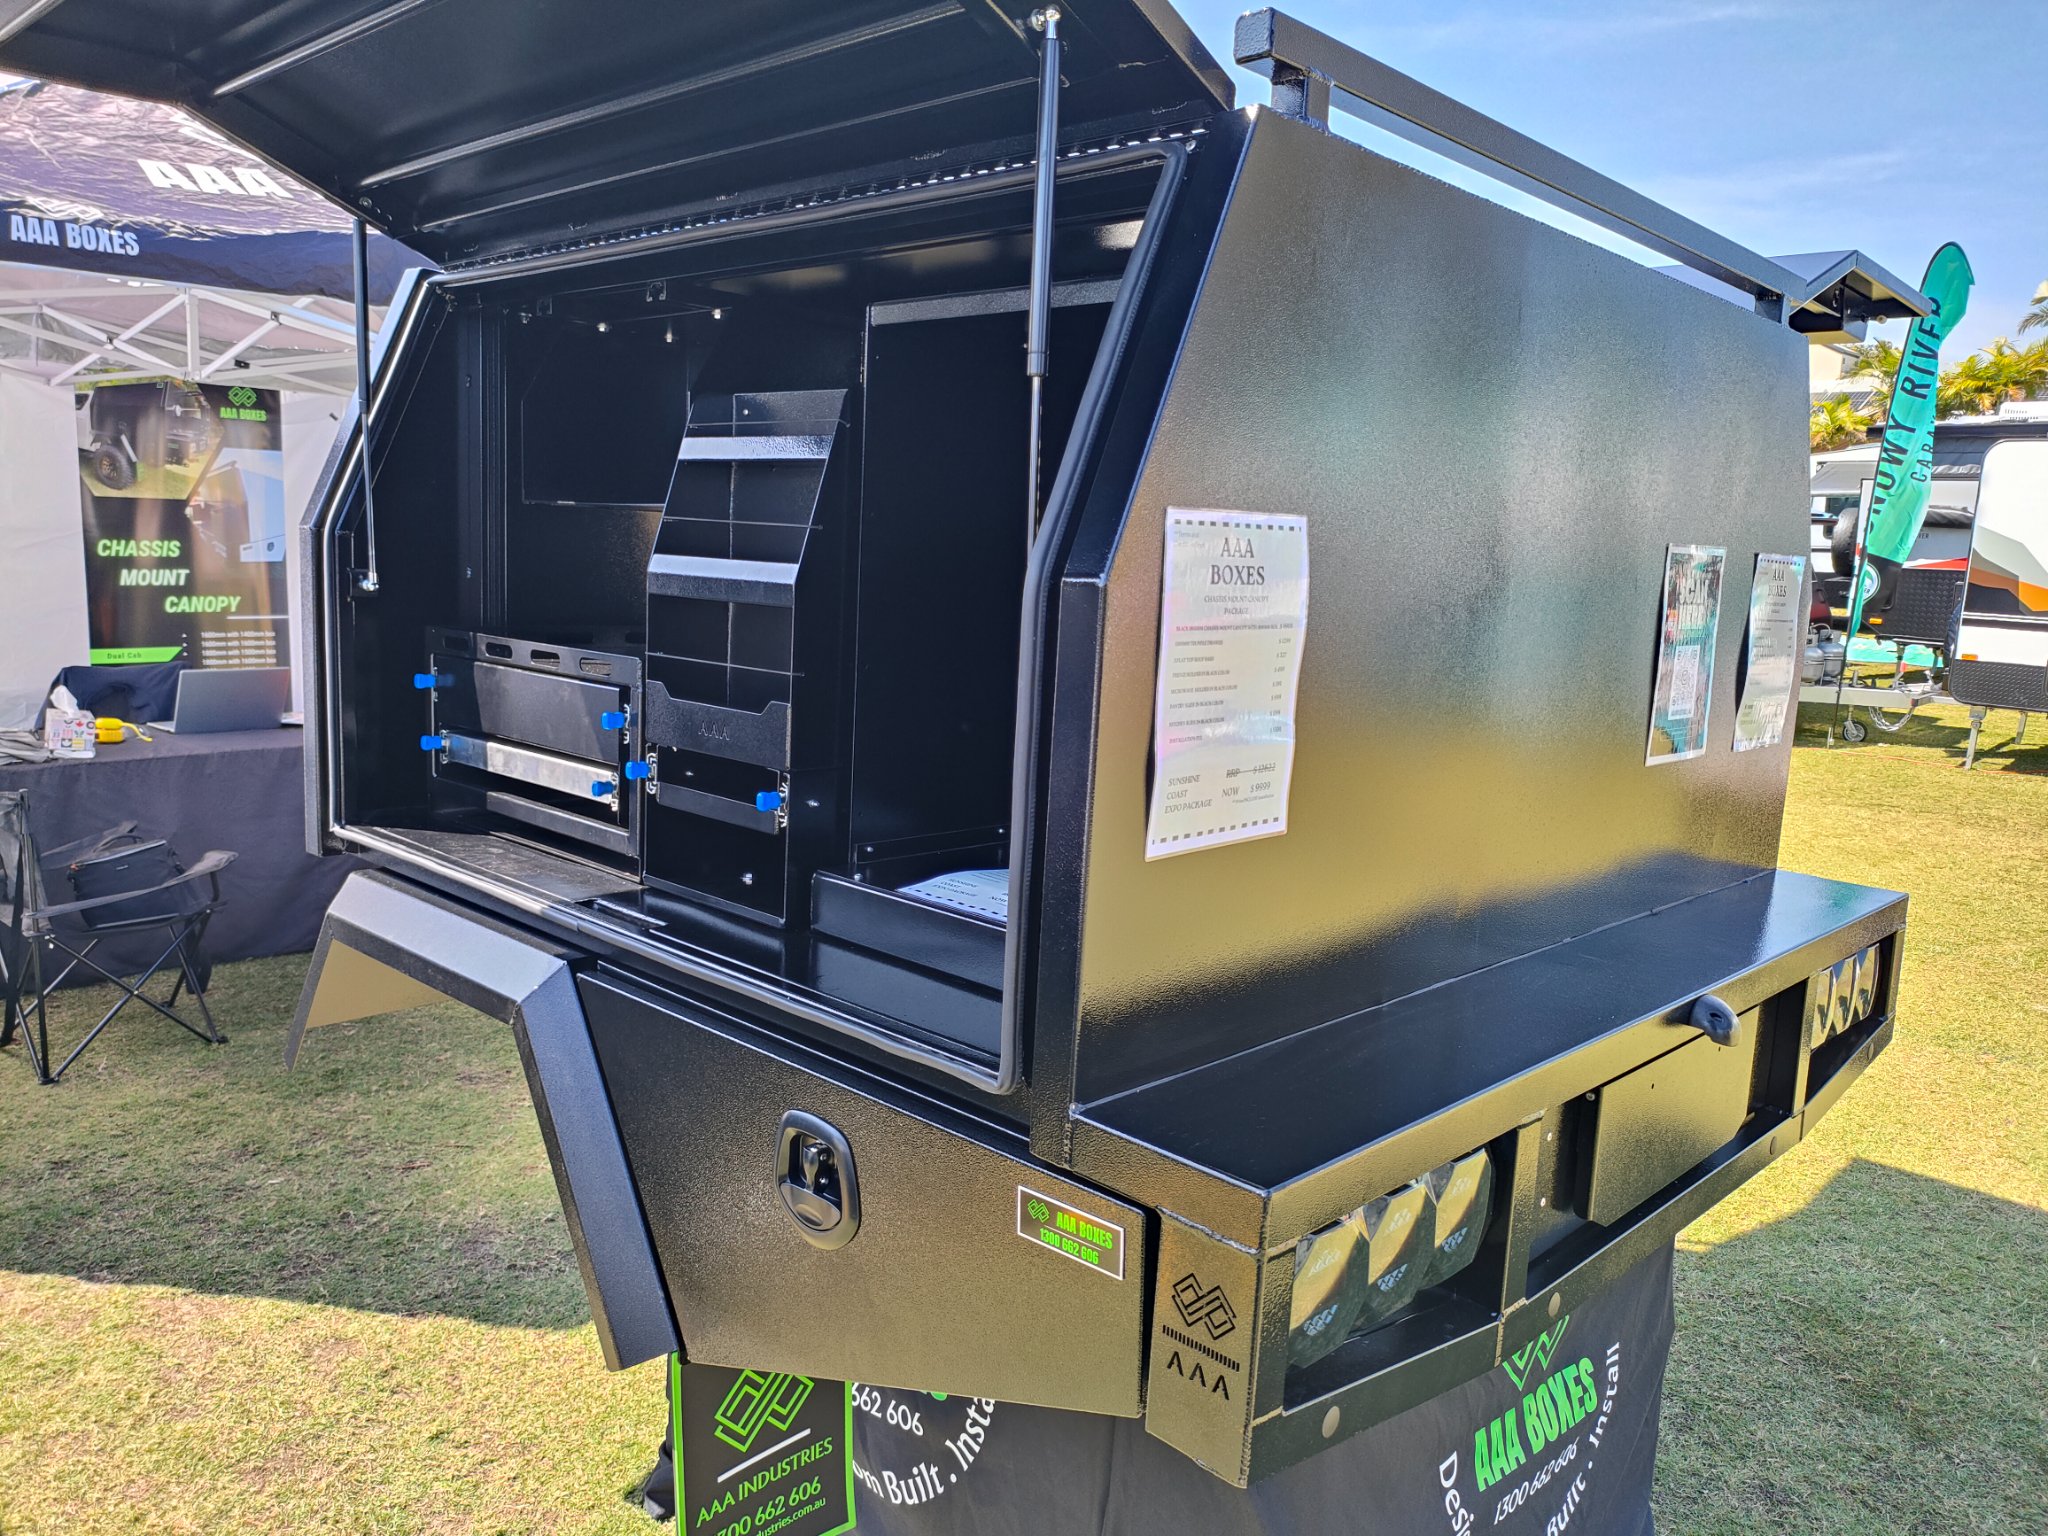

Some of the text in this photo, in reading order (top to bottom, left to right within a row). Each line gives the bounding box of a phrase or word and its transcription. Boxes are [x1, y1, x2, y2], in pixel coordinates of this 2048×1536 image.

[137, 159, 294, 198] AAA
[11, 214, 140, 256] AAA BOXES
[219, 407, 267, 422] AAA BOXES
[97, 539, 181, 557] CHASSIS
[1220, 537, 1255, 559] AAA
[120, 569, 190, 586] MOUNT
[1210, 564, 1265, 586] BOXES
[1772, 568, 1785, 582] AAA
[165, 596, 241, 612] CANOPY
[107, 652, 125, 660] Dual
[698, 722, 730, 741] AAA
[1166, 789, 1188, 801] COAST
[1168, 774, 1201, 787] SUNSHINE
[1221, 786, 1240, 798] NOW
[1164, 799, 1213, 814] EXPO PACKAGE
[1056, 1211, 1113, 1250] AAA BOXES
[1040, 1228, 1099, 1265] 1300 662 606
[1167, 1351, 1230, 1400] AAA
[852, 1382, 924, 1436] 662 606
[1588, 1341, 1621, 1449] Install
[1474, 1356, 1599, 1493] AAA BOXES
[882, 1462, 945, 1506] Built
[944, 1397, 996, 1472] Insta
[696, 1490, 736, 1529] AAA
[738, 1437, 834, 1502] INDUSTRIES
[755, 1495, 786, 1526] 662
[788, 1475, 822, 1507] 606
[1493, 1481, 1530, 1526] 1300
[755, 1497, 827, 1536] dustries.com.au
